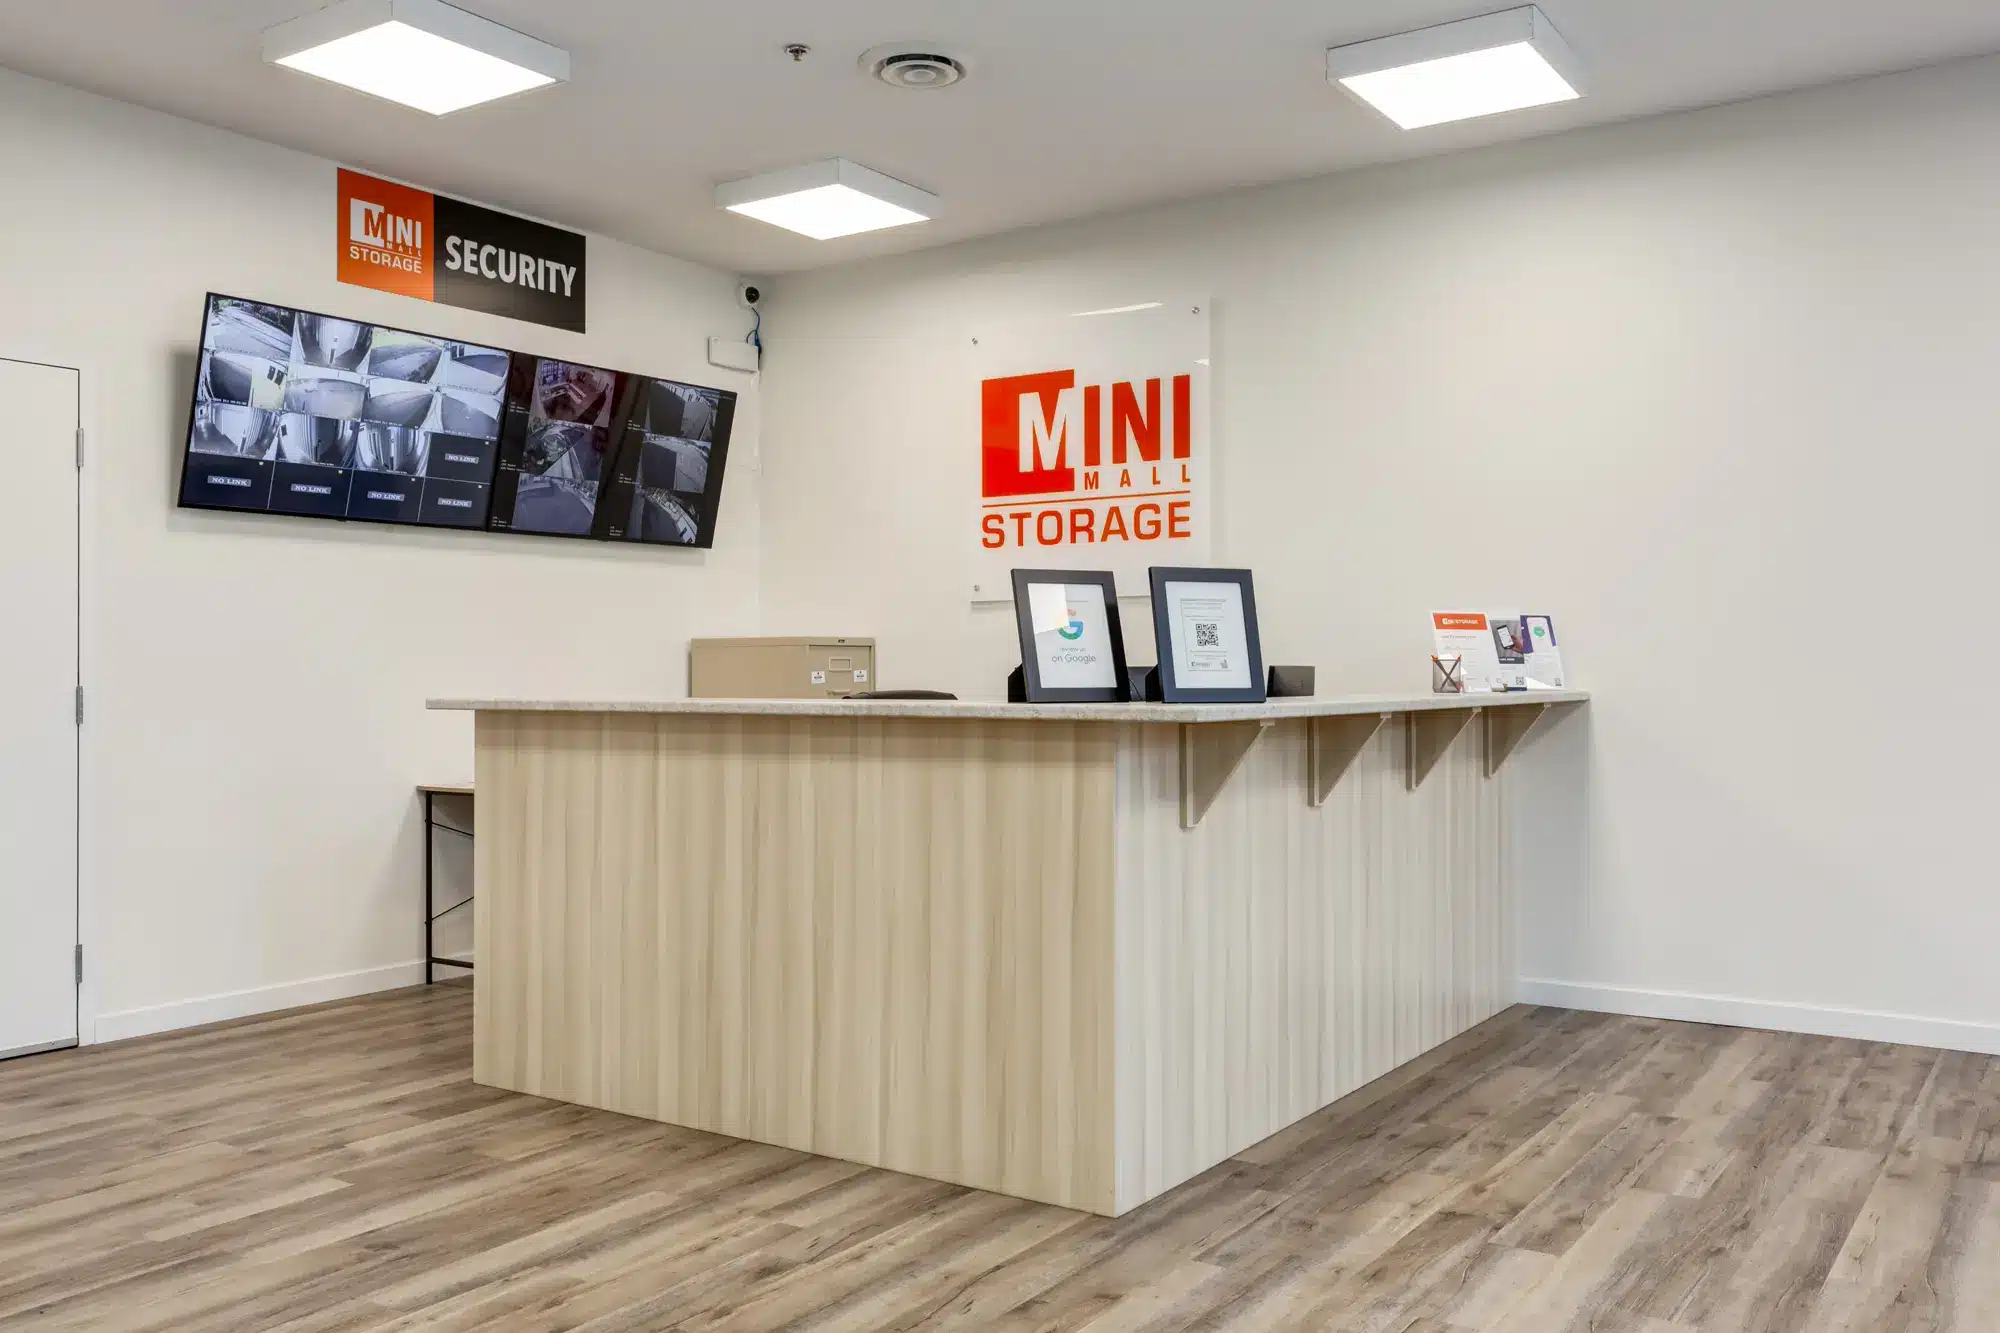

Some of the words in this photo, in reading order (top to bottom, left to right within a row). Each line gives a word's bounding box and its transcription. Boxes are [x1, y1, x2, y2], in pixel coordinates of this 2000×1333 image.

[350, 198, 422, 249] MINI
[349, 246, 423, 274] STORAGE
[386, 241, 422, 258] MALL
[444, 235, 577, 297] SECURITY
[982, 369, 1191, 497] MINI
[226, 478, 248, 486] LINK
[1084, 464, 1191, 491] MALL
[981, 500, 1191, 549] STORAGE
[1052, 655, 1063, 663] on
[1064, 653, 1097, 665] Google
